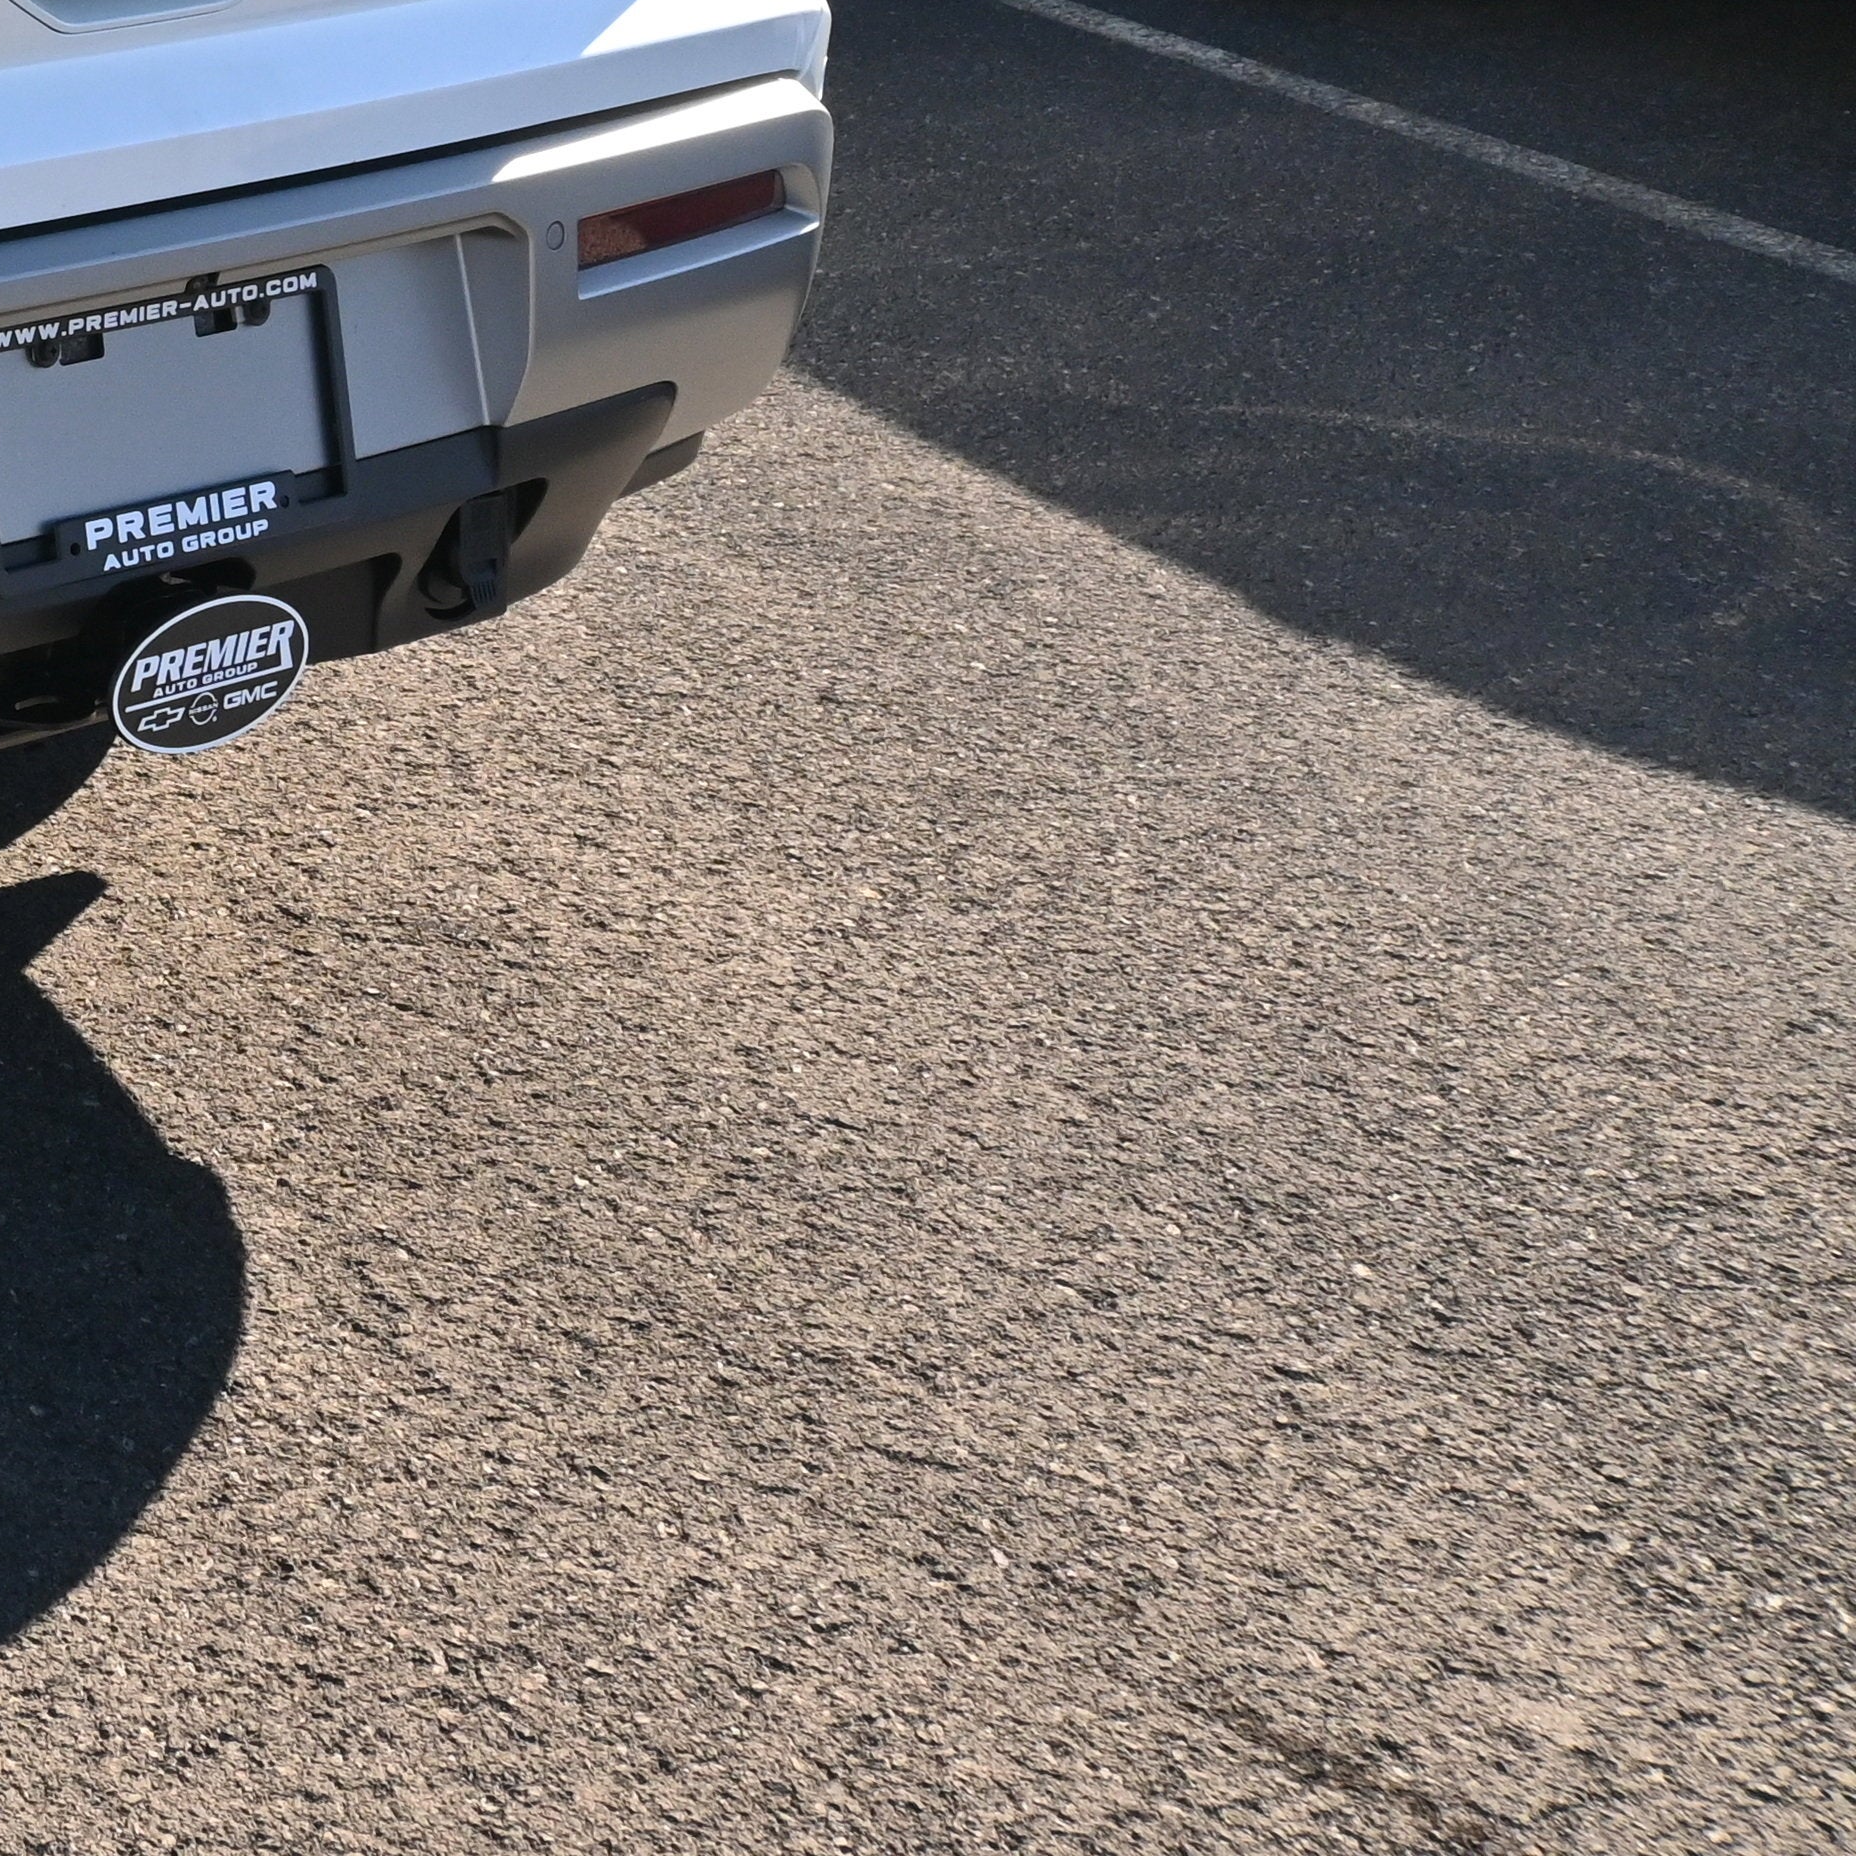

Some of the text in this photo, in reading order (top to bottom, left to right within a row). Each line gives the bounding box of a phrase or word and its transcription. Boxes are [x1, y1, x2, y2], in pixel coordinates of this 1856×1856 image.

[85, 480, 278, 552] PREMIER
[103, 519, 270, 572] AUTO GROUP
[131, 619, 295, 693] PREMIER
[152, 662, 258, 699] AUTO GROUP
[223, 681, 278, 710] GMC
